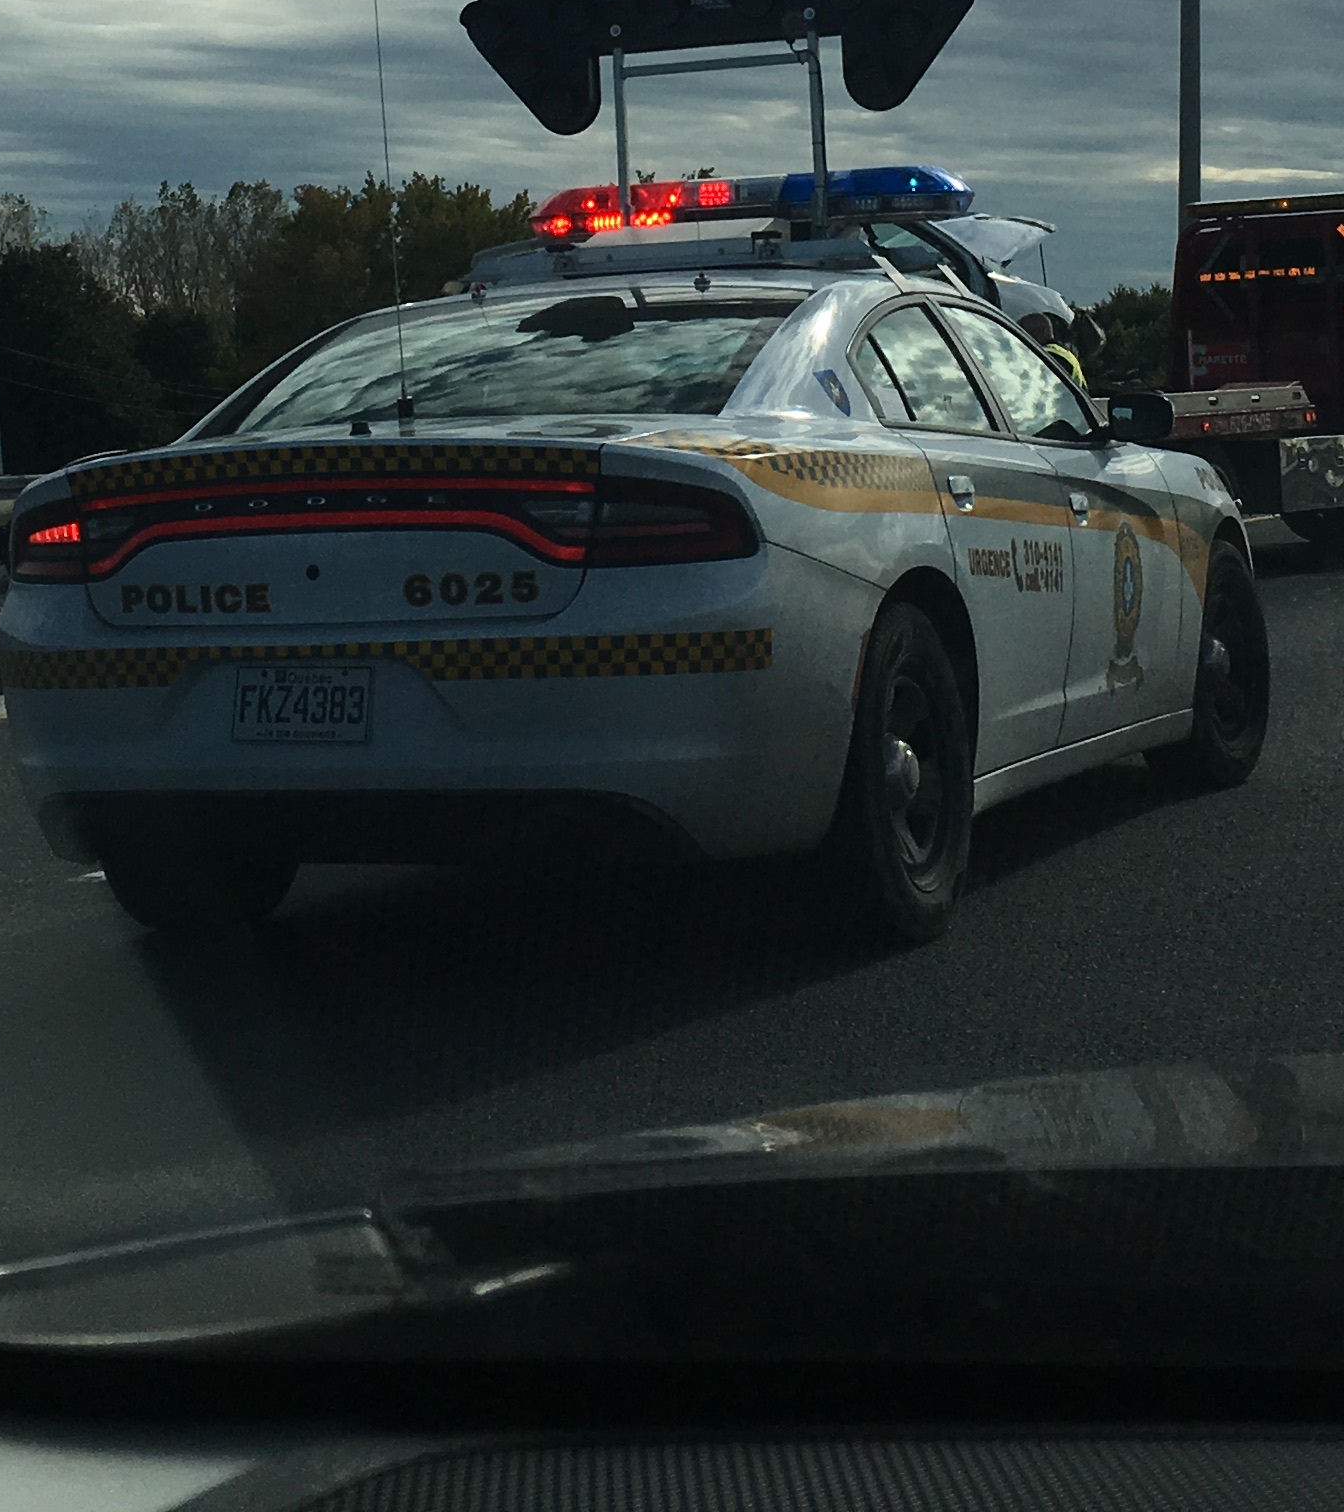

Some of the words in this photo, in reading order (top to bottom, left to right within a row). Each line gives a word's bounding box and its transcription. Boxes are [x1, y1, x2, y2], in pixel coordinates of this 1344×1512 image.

[194, 494, 447, 512] DODGE
[968, 548, 1011, 578] URGENCE
[120, 583, 272, 614] POLICE
[403, 569, 543, 607] 6025
[239, 685, 366, 724] FKZ4383
